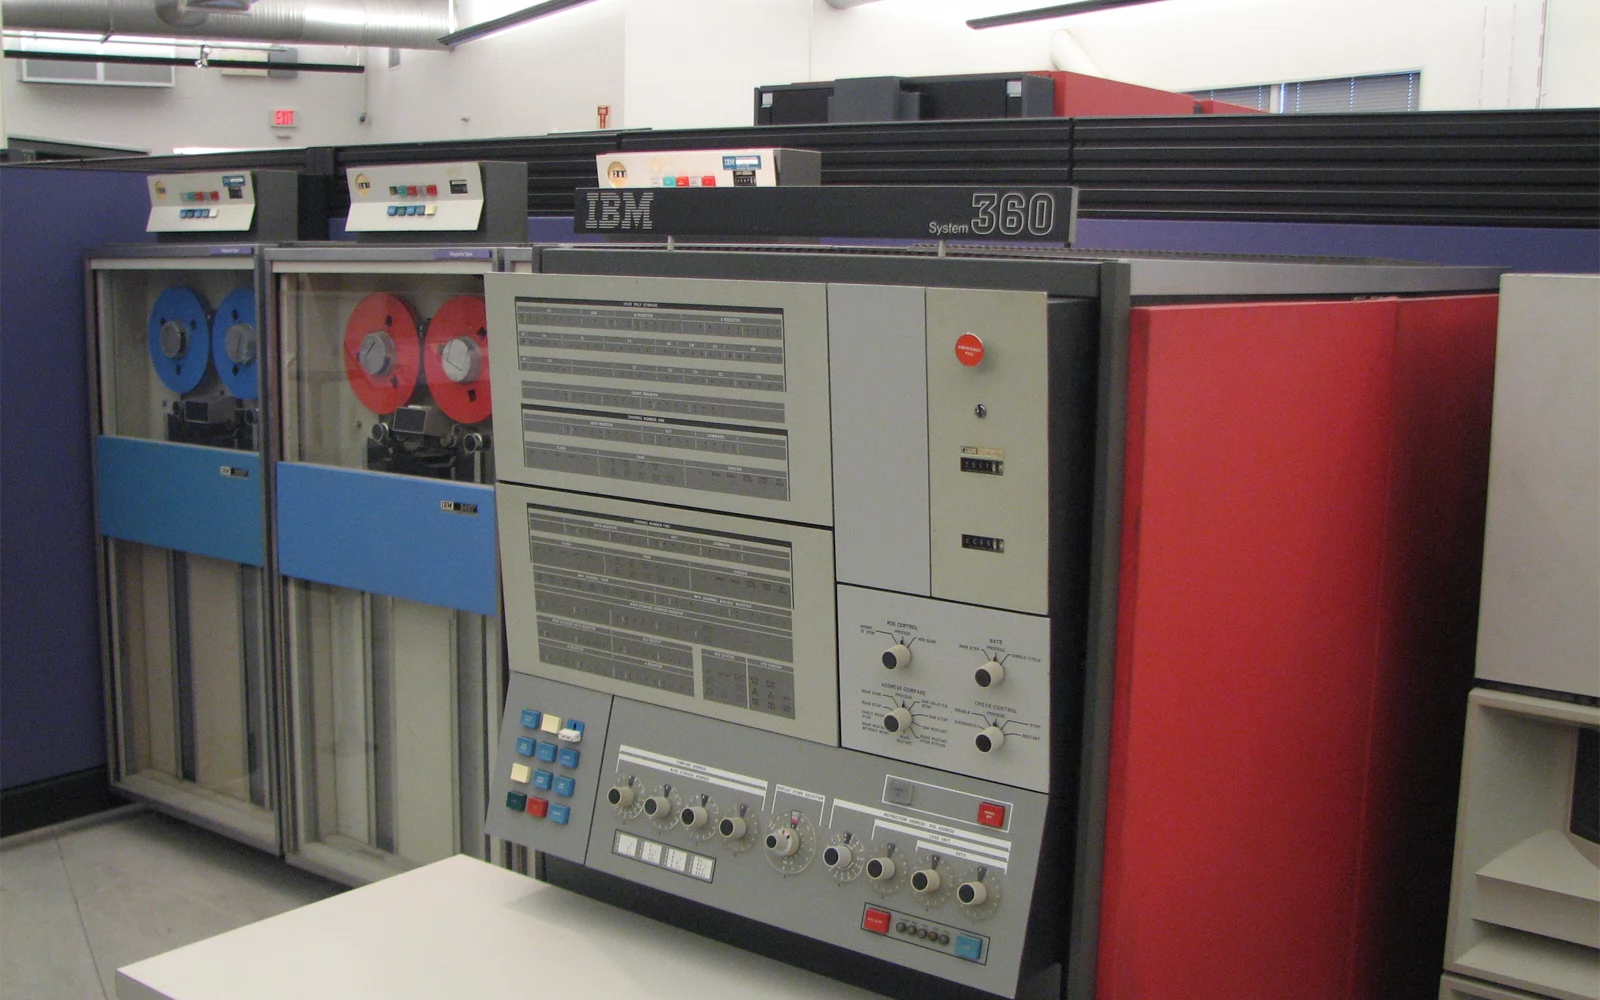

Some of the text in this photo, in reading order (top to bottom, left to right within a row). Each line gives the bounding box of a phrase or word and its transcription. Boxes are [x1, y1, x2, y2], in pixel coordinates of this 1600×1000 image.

[276, 110, 294, 125] EXIT
[585, 192, 654, 230] IBM
[929, 193, 1054, 236] System 360
[897, 622, 919, 631] CONTROL
[989, 638, 1003, 646] RATE
[881, 682, 926, 696] ADDRESS COMPARE
[974, 701, 1017, 714] CHECK CONTROL
[1022, 733, 1041, 742] RESTART
[883, 812, 908, 822] INSTRUCTION
[909, 819, 926, 828] ADDRESS
[938, 826, 955, 834] ADDRESS
